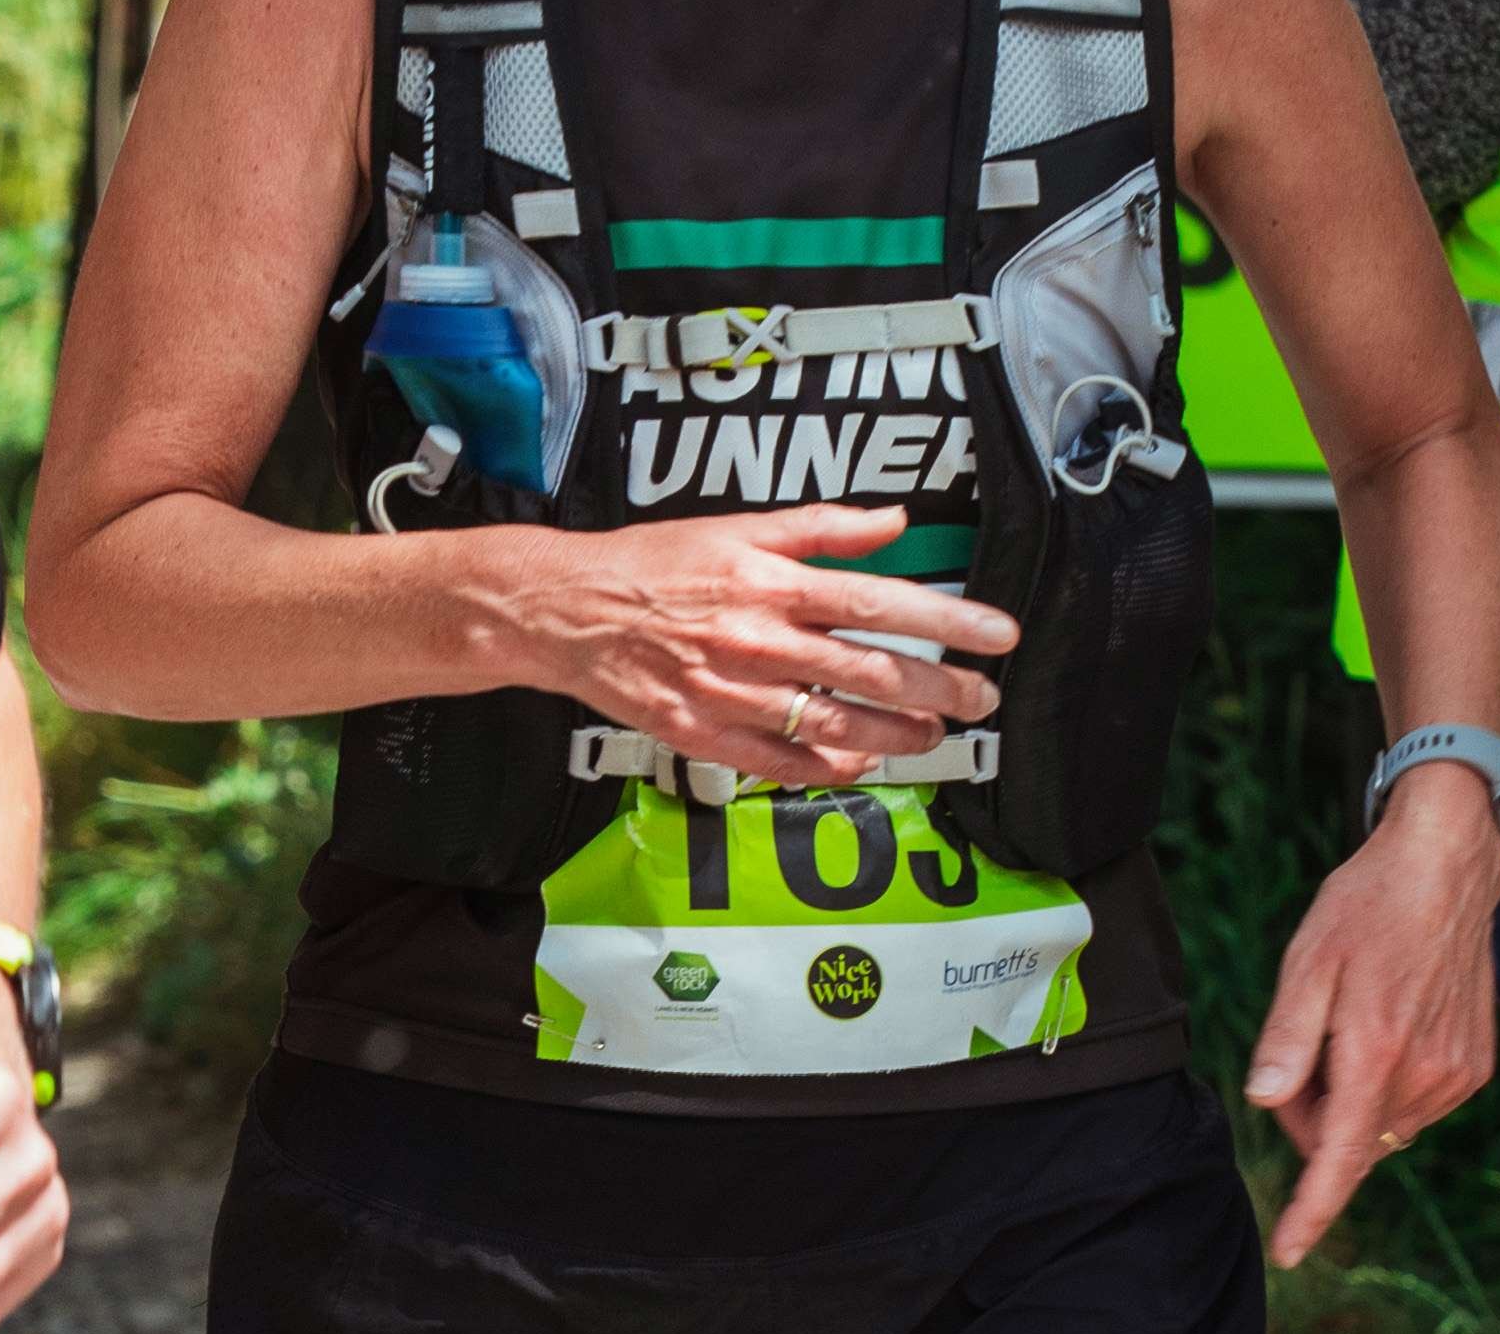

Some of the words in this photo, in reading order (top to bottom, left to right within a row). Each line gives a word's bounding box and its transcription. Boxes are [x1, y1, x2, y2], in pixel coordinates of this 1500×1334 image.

[619, 412, 980, 508] UNNER
[663, 966, 709, 983] green
[818, 953, 872, 984] Nice
[673, 977, 708, 991] rock
[811, 976, 878, 1005] Work
